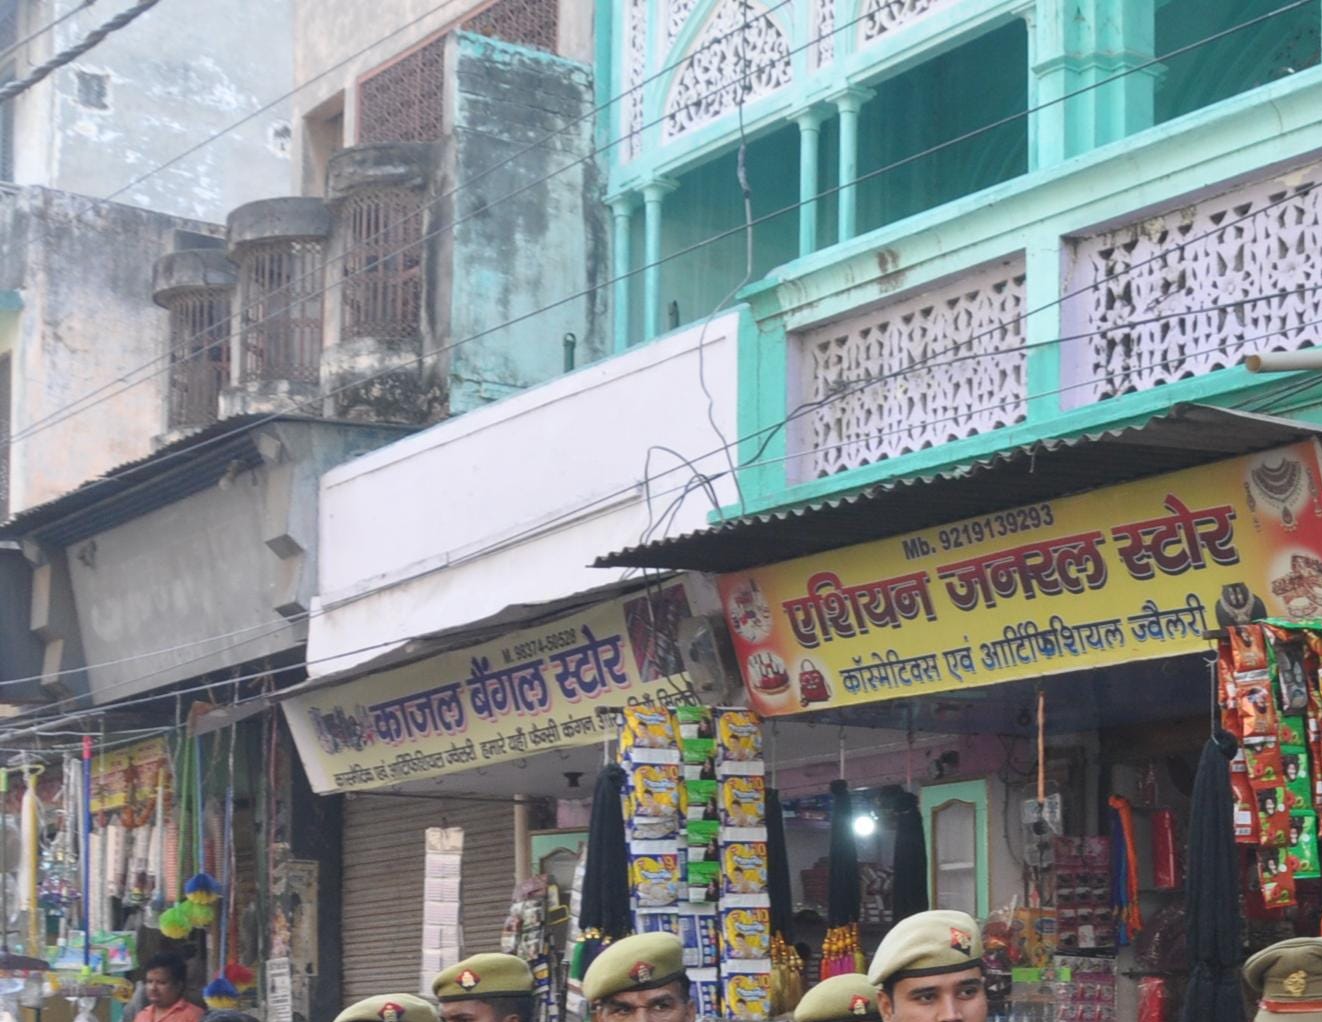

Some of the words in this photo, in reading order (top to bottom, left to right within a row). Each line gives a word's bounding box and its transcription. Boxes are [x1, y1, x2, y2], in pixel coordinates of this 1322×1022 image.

[783, 571, 937, 648] एशियन
[936, 529, 1108, 611] जनरल
[1111, 493, 1239, 580] स्टोर
[902, 536, 937, 560] Mb.
[939, 504, 1055, 551] 9219139293
[368, 682, 468, 743] काजल
[549, 623, 631, 701] स्टोर
[839, 649, 942, 694] कॉस्मेटिक्स
[943, 635, 976, 682] एवं
